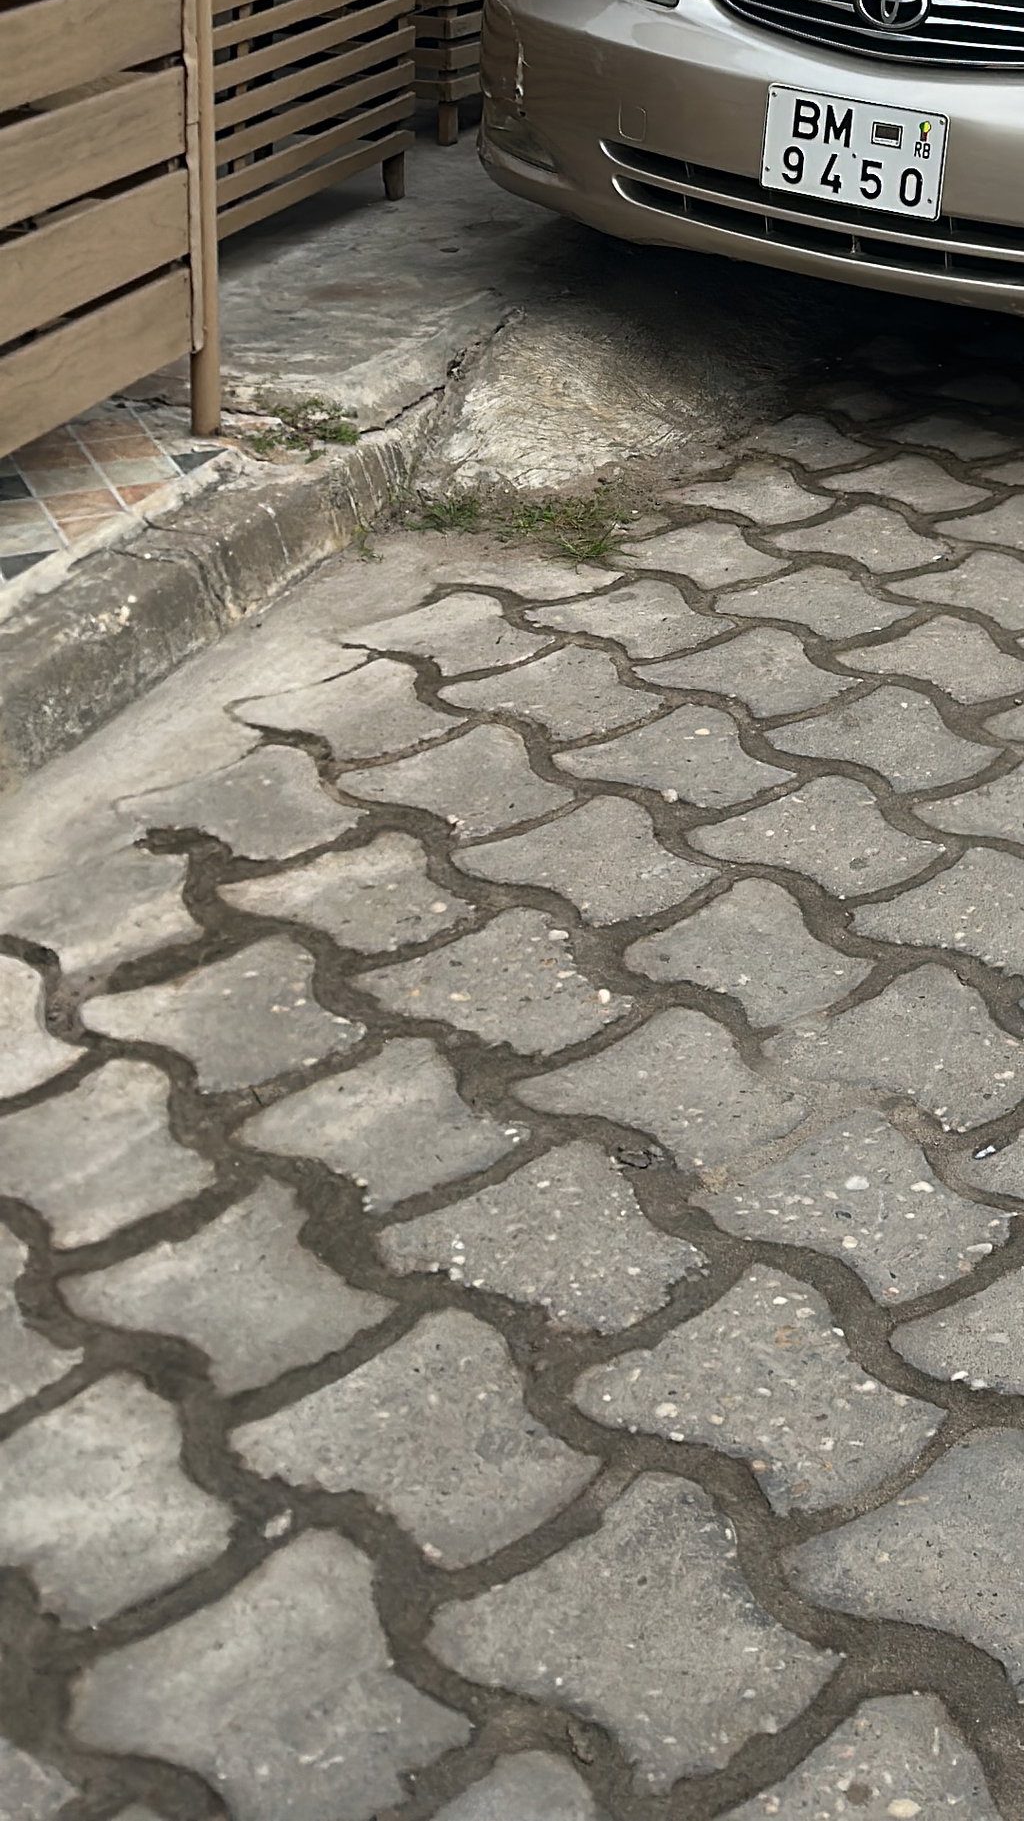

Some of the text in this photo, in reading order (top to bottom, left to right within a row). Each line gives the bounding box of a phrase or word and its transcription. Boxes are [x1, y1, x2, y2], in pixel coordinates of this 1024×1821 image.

[792, 98, 853, 148] BM
[914, 141, 931, 159] RB
[781, 146, 923, 206] 9450
